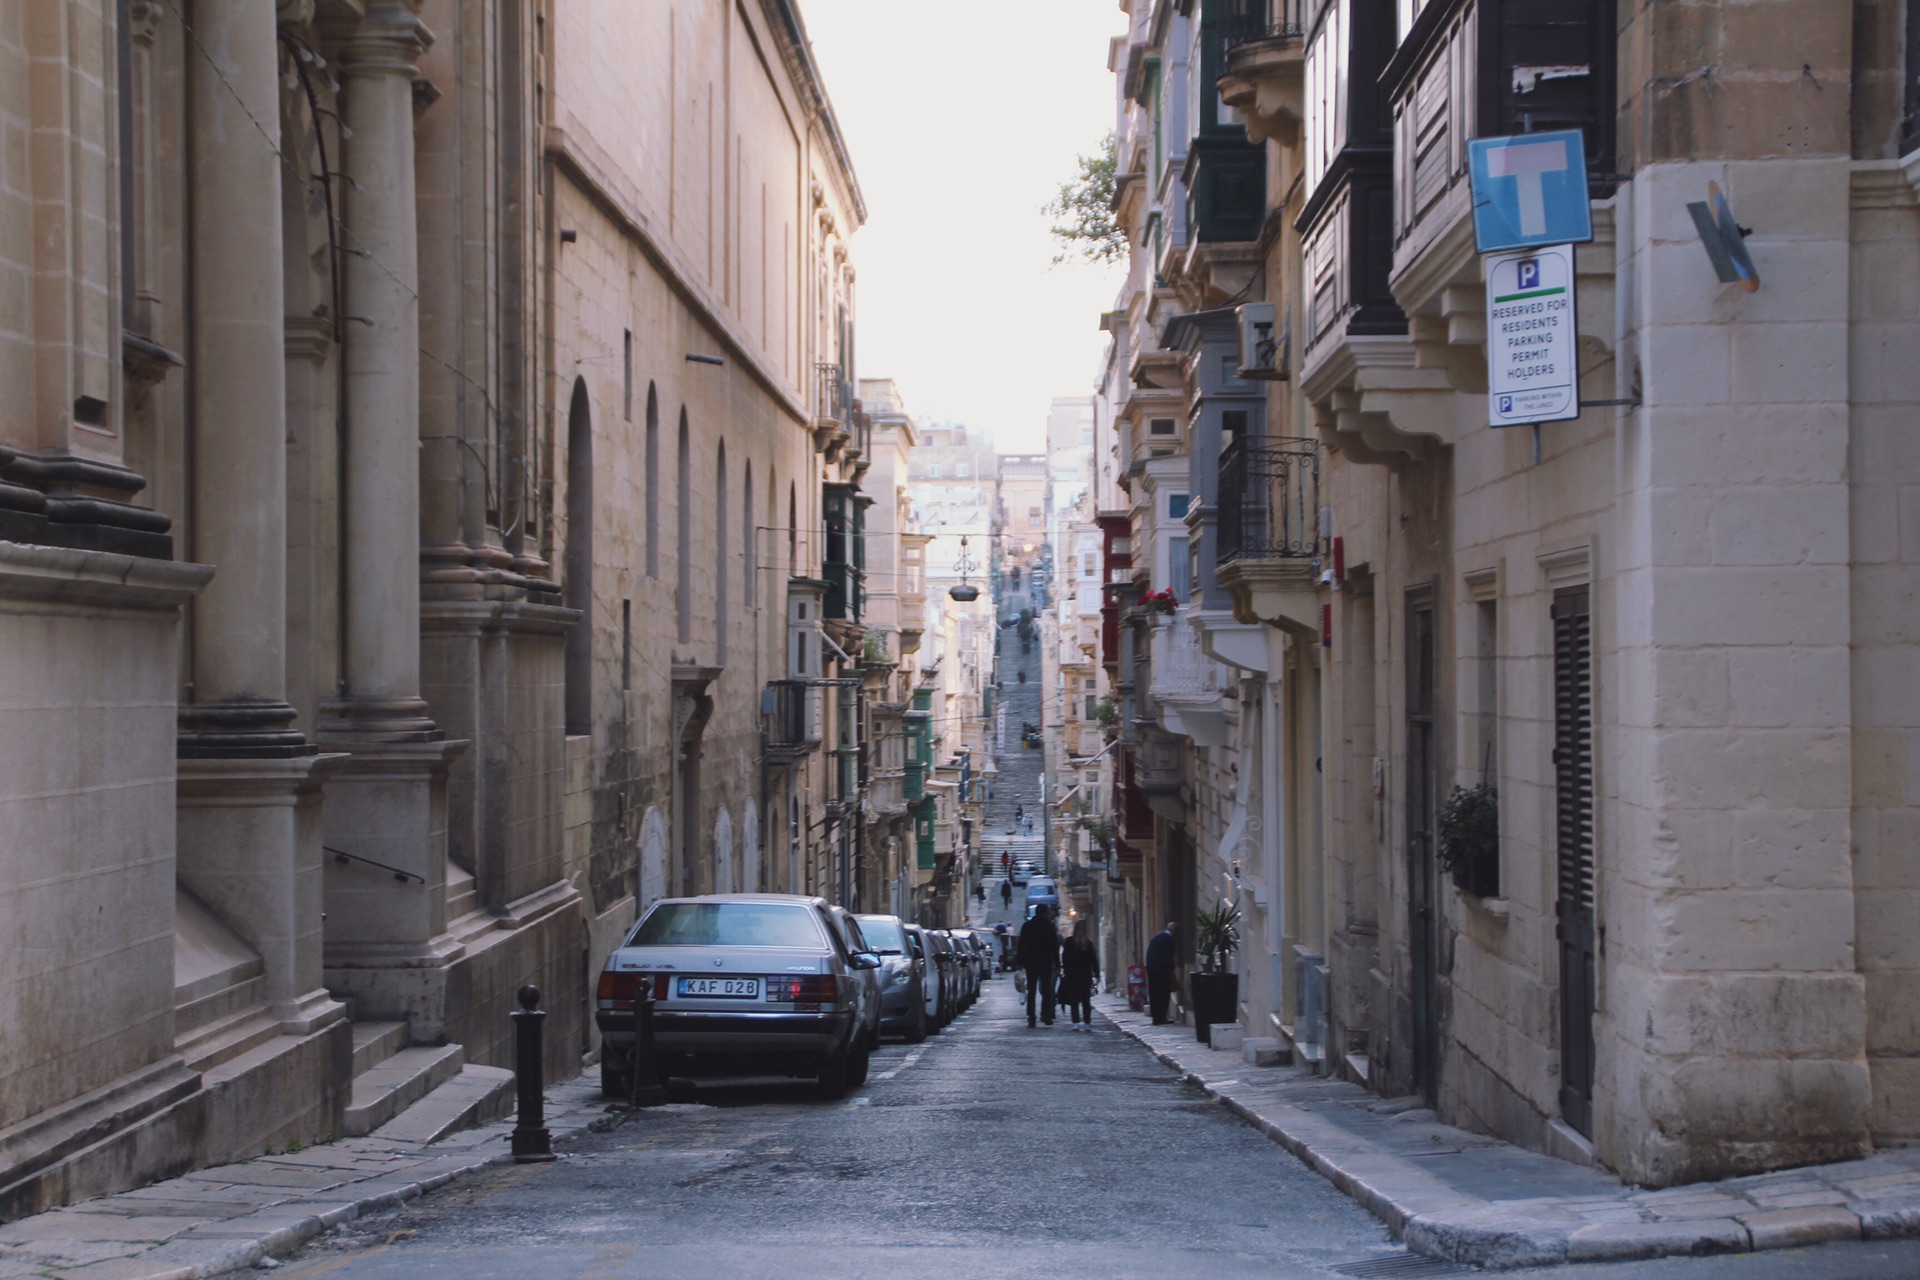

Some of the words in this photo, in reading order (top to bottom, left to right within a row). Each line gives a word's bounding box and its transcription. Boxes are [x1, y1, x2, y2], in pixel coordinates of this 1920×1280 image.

[1521, 263, 1536, 287] P
[1493, 302, 1544, 319] RESERVED
[1547, 299, 1567, 311] FOR
[1502, 316, 1558, 333] RESIDENTS
[1508, 333, 1553, 348] PARKING
[1513, 349, 1549, 362] PERMIT
[1507, 364, 1555, 379] HOLDERS
[686, 980, 718, 993] KAF
[725, 980, 755, 994] 028
